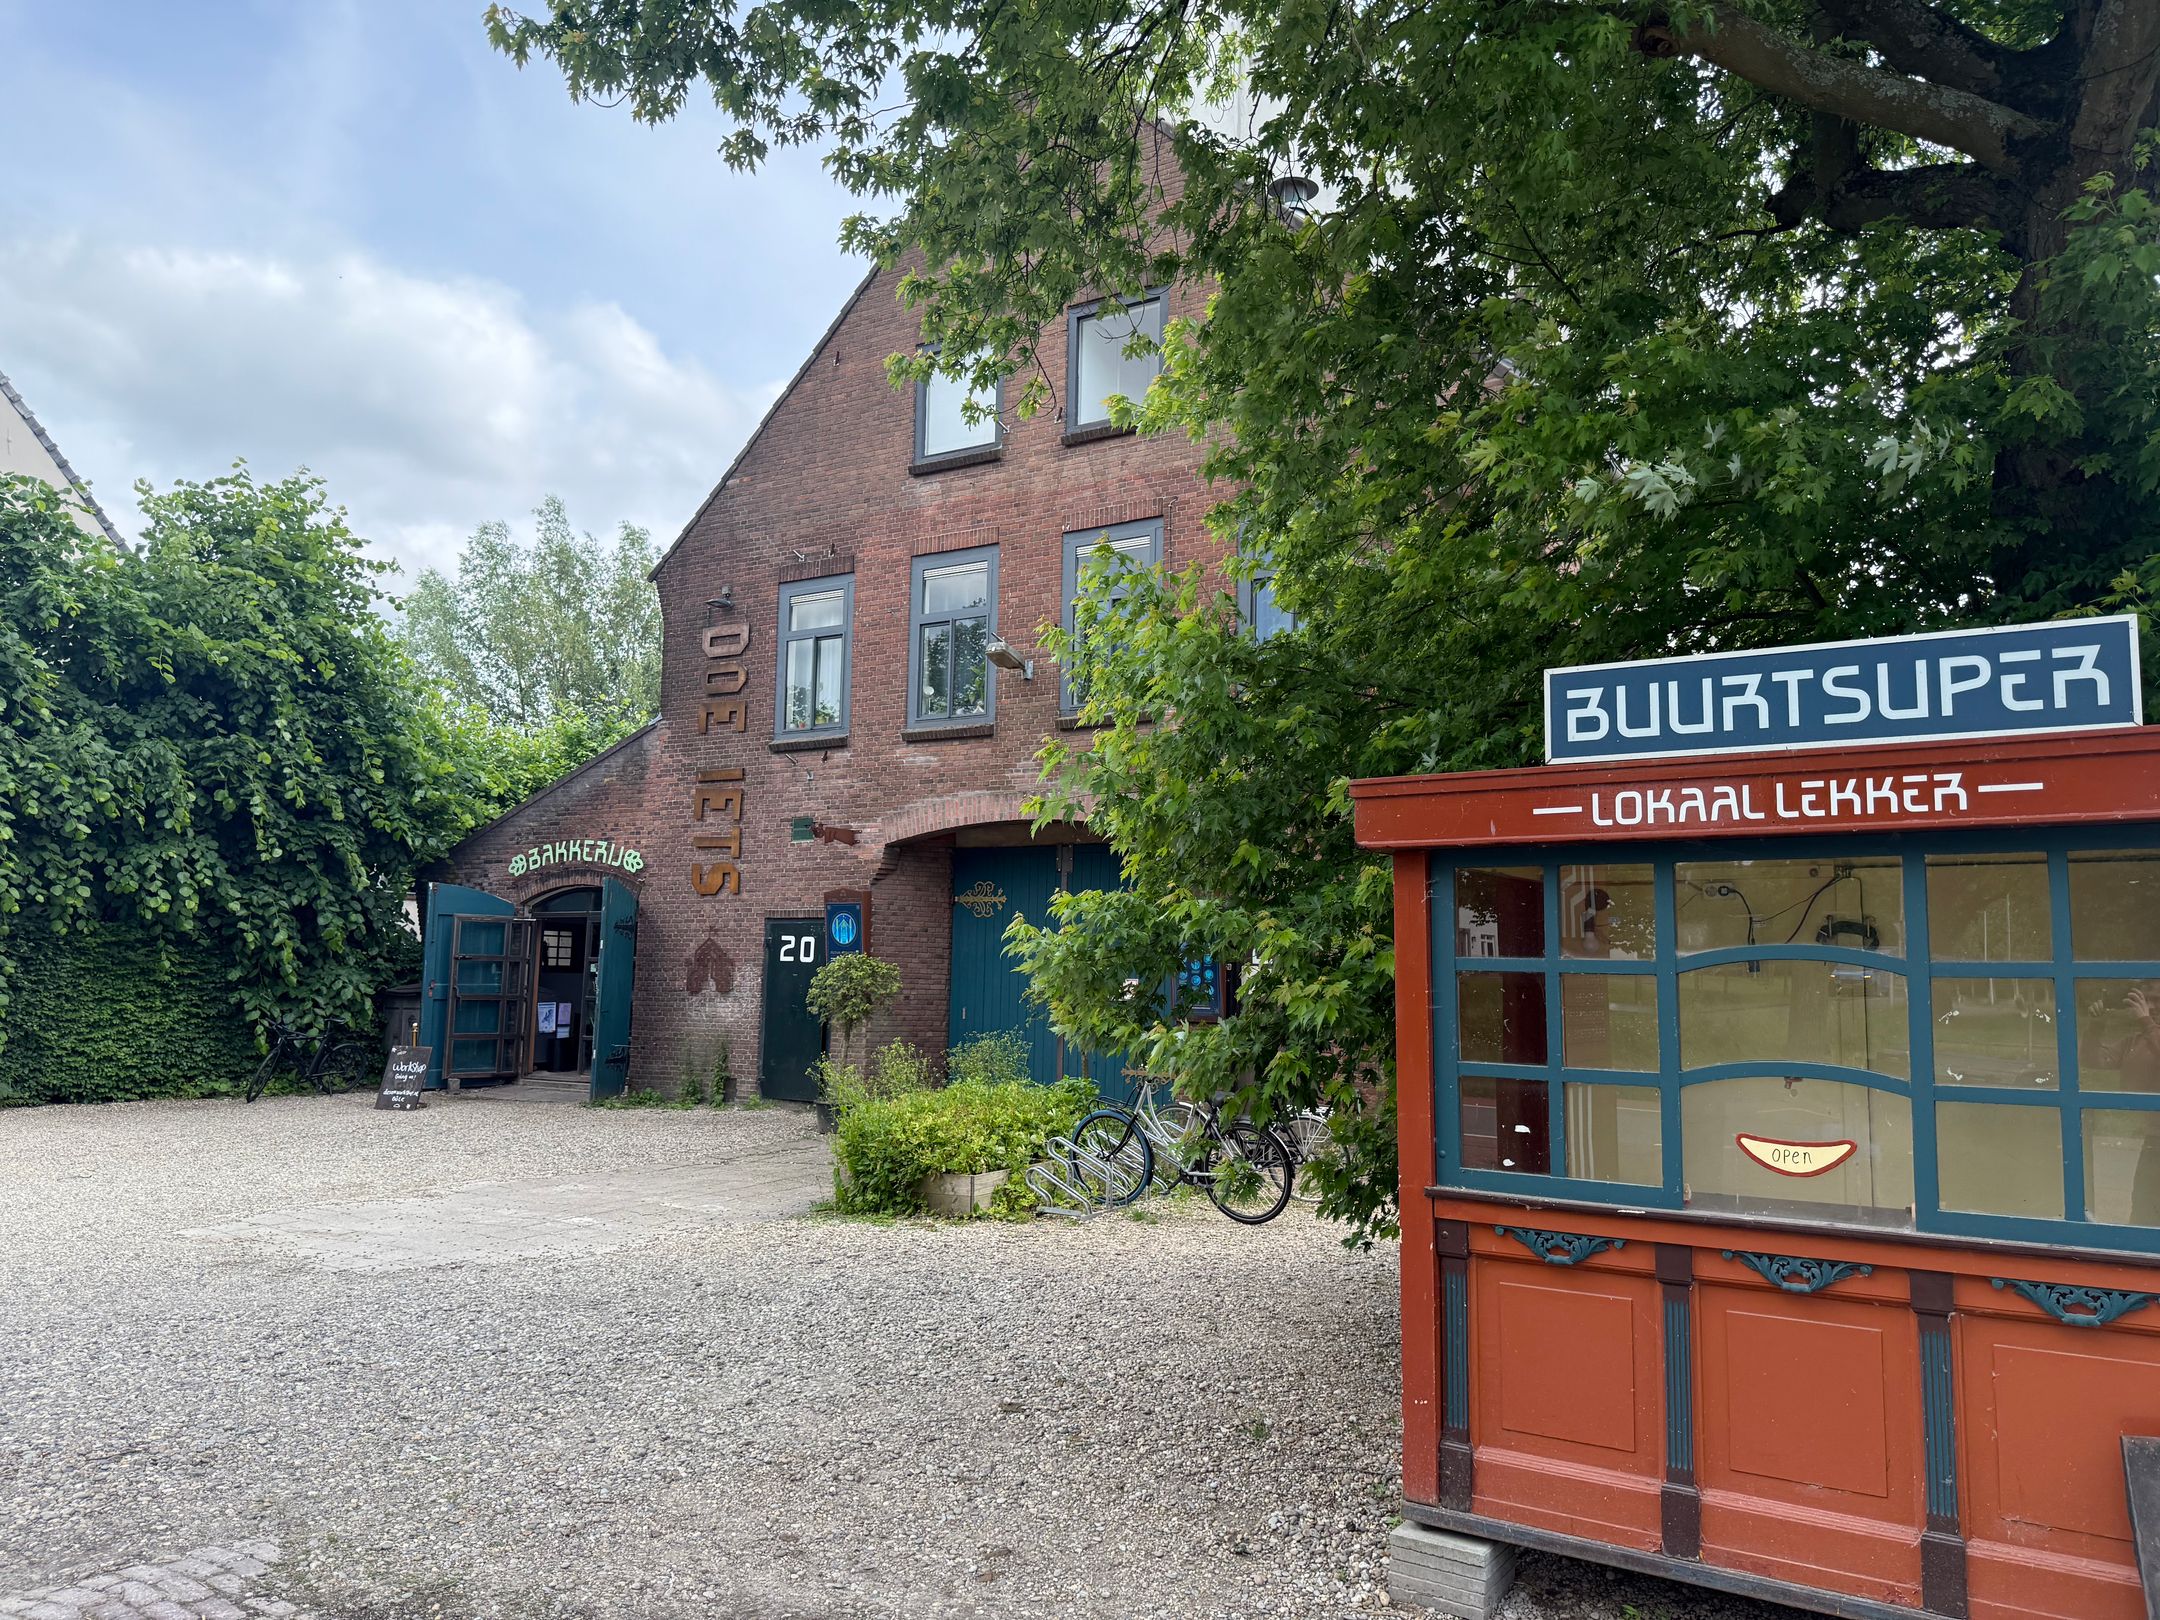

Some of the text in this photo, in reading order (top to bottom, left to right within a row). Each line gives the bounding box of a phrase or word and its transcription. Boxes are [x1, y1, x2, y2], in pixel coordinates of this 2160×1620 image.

[1566, 644, 2111, 742] BUURTSUPER
[692, 622, 750, 895] DOE IETS
[1592, 772, 1968, 826] LOKAAL LEKKER
[528, 839, 625, 870] BAKKERIJ
[779, 935, 816, 962] 20
